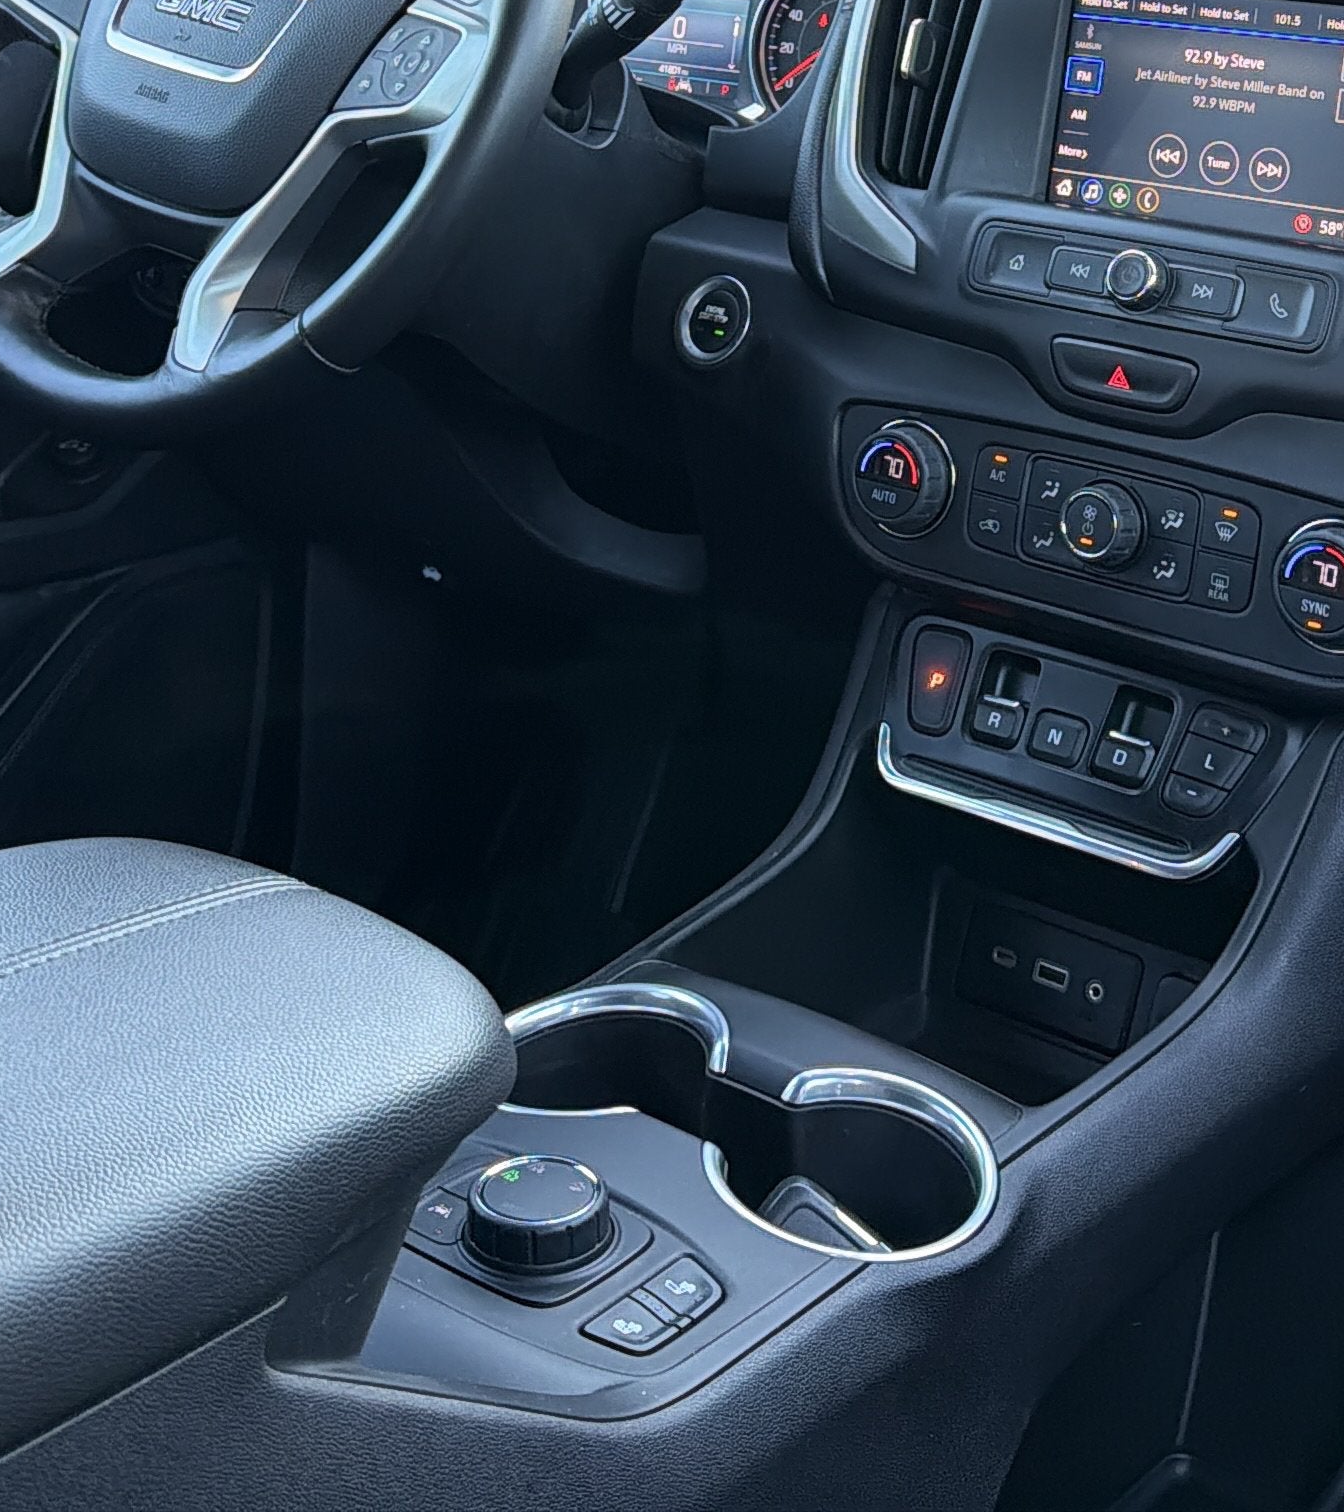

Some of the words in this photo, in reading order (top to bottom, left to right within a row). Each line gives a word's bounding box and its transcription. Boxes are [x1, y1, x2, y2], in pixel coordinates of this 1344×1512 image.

[1102, 0, 1112, 8] to
[1113, 0, 1129, 10] Set
[1140, 1, 1160, 14] Hold
[1162, 4, 1171, 14] to
[1172, 4, 1188, 16] Set
[788, 9, 804, 22] 40
[1200, 7, 1222, 20] Hold
[1222, 10, 1232, 20] to
[1234, 10, 1250, 22] Set
[1274, 14, 1302, 27] 101.5
[672, 16, 688, 39] 0
[666, 43, 688, 56] MPH
[779, 41, 795, 55] 20
[1184, 48, 1212, 64] 92.9
[1214, 50, 1229, 70] by
[1230, 53, 1265, 70] Steve
[1076, 70, 1092, 82] FM
[1135, 67, 1152, 82] Jet
[1154, 68, 1192, 85] Airliner
[1194, 73, 1209, 90] by
[1210, 75, 1240, 92] Steve
[1242, 79, 1276, 95] Miller
[1277, 83, 1308, 98] Band
[1309, 89, 1326, 100] on
[720, 84, 730, 96] P
[1192, 95, 1218, 110] 92.9
[1218, 98, 1256, 114] WBPM
[1070, 108, 1088, 122] AM
[1058, 144, 1082, 158] More
[1207, 156, 1230, 170] Tune
[884, 454, 904, 480] 70
[989, 468, 1006, 484] A/C
[871, 488, 897, 505] AUTO
[1312, 560, 1339, 588] 70
[1208, 589, 1230, 602] REAR
[1300, 598, 1330, 618] SYNC
[929, 672, 946, 688] P
[988, 711, 1002, 728] R
[1046, 728, 1064, 746] N
[1112, 748, 1128, 766] D
[1204, 753, 1215, 772] L
